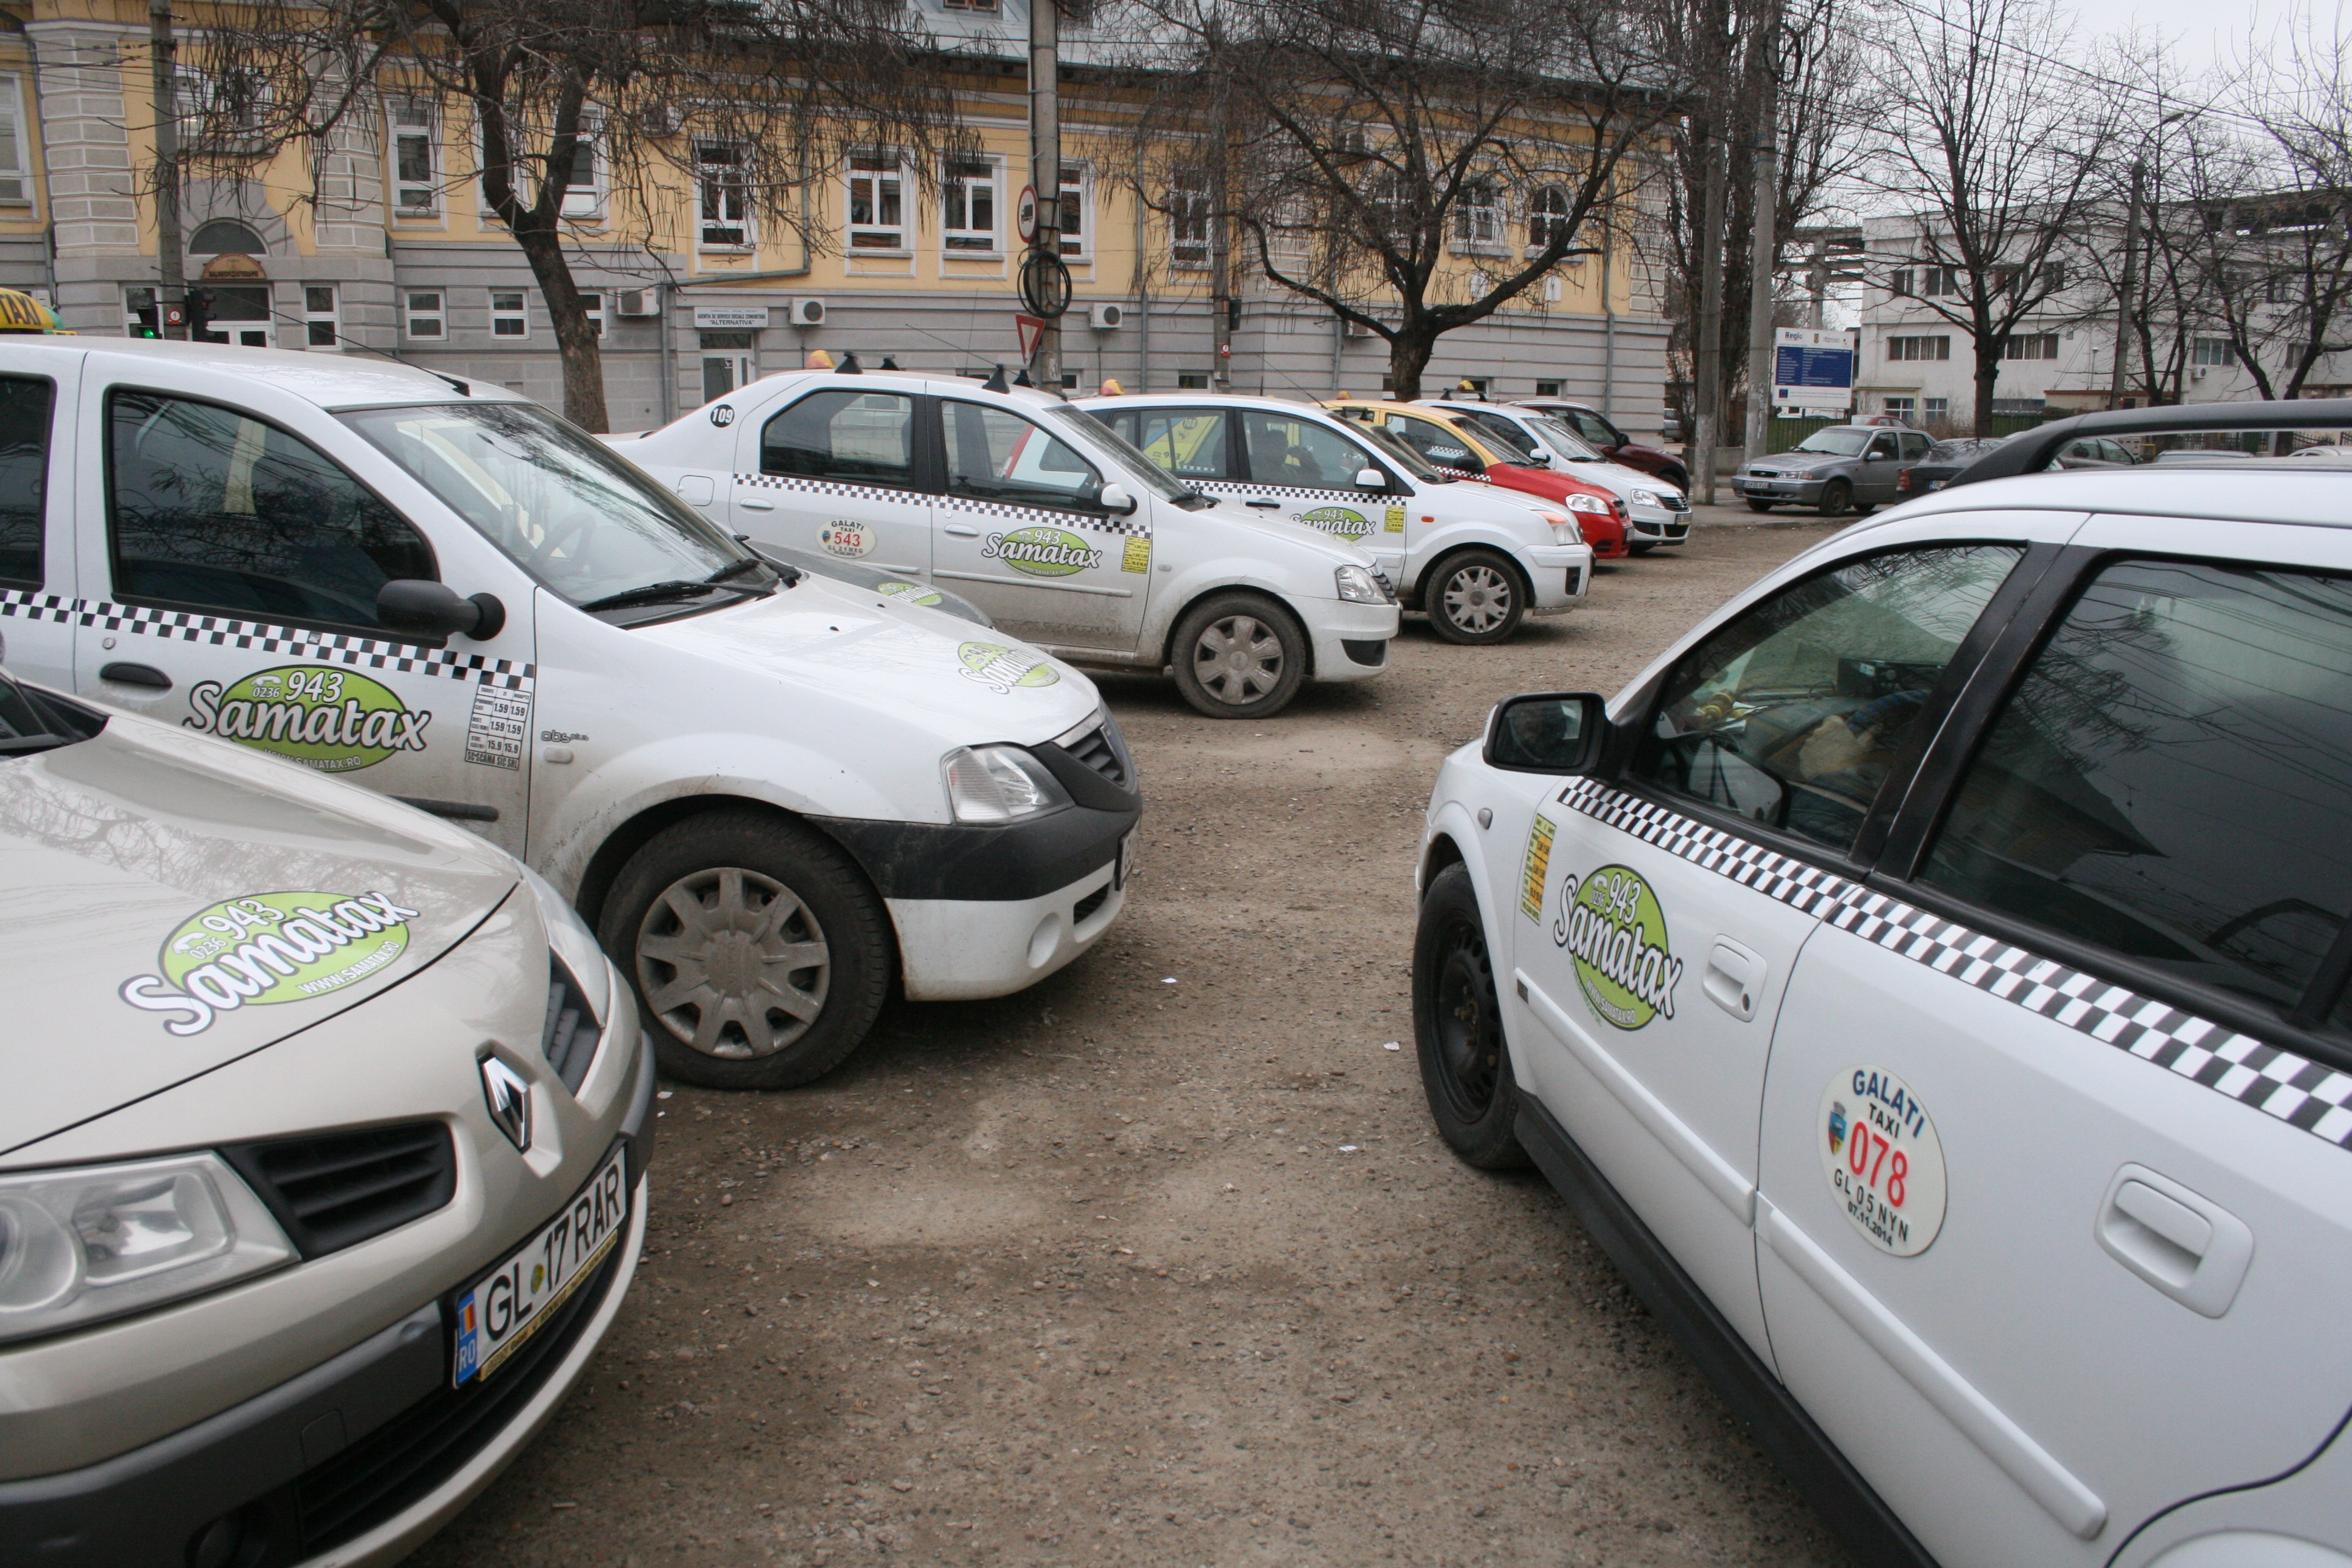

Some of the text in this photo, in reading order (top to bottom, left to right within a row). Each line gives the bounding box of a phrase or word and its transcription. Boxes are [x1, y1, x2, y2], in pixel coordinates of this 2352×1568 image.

[712, 408, 733, 423] 109
[1164, 451, 1181, 460] 93
[831, 520, 864, 531] GALATI
[1323, 509, 1344, 520] 943
[834, 532, 860, 546] 543
[981, 532, 1102, 569] Samatax
[1033, 529, 1062, 545] 943
[252, 671, 344, 703] 0236 943
[183, 680, 432, 751] Samatax
[541, 730, 570, 743] abs
[1606, 872, 1642, 925] 943
[189, 899, 286, 960] 0236 943
[1553, 874, 1683, 1020] Samatax
[119, 890, 420, 1037] Samatax
[297, 940, 402, 994] WWW.SAMATAX.RO
[1852, 1070, 1924, 1138] GALATI
[1869, 1102, 1900, 1138] TAXI
[1849, 1121, 1908, 1208] 078
[1834, 1168, 1908, 1242] GL 05 NYN
[486, 1261, 532, 1341] GL
[544, 1214, 570, 1293] 17
[575, 1163, 619, 1265] RAR
[458, 1339, 476, 1372] RO
